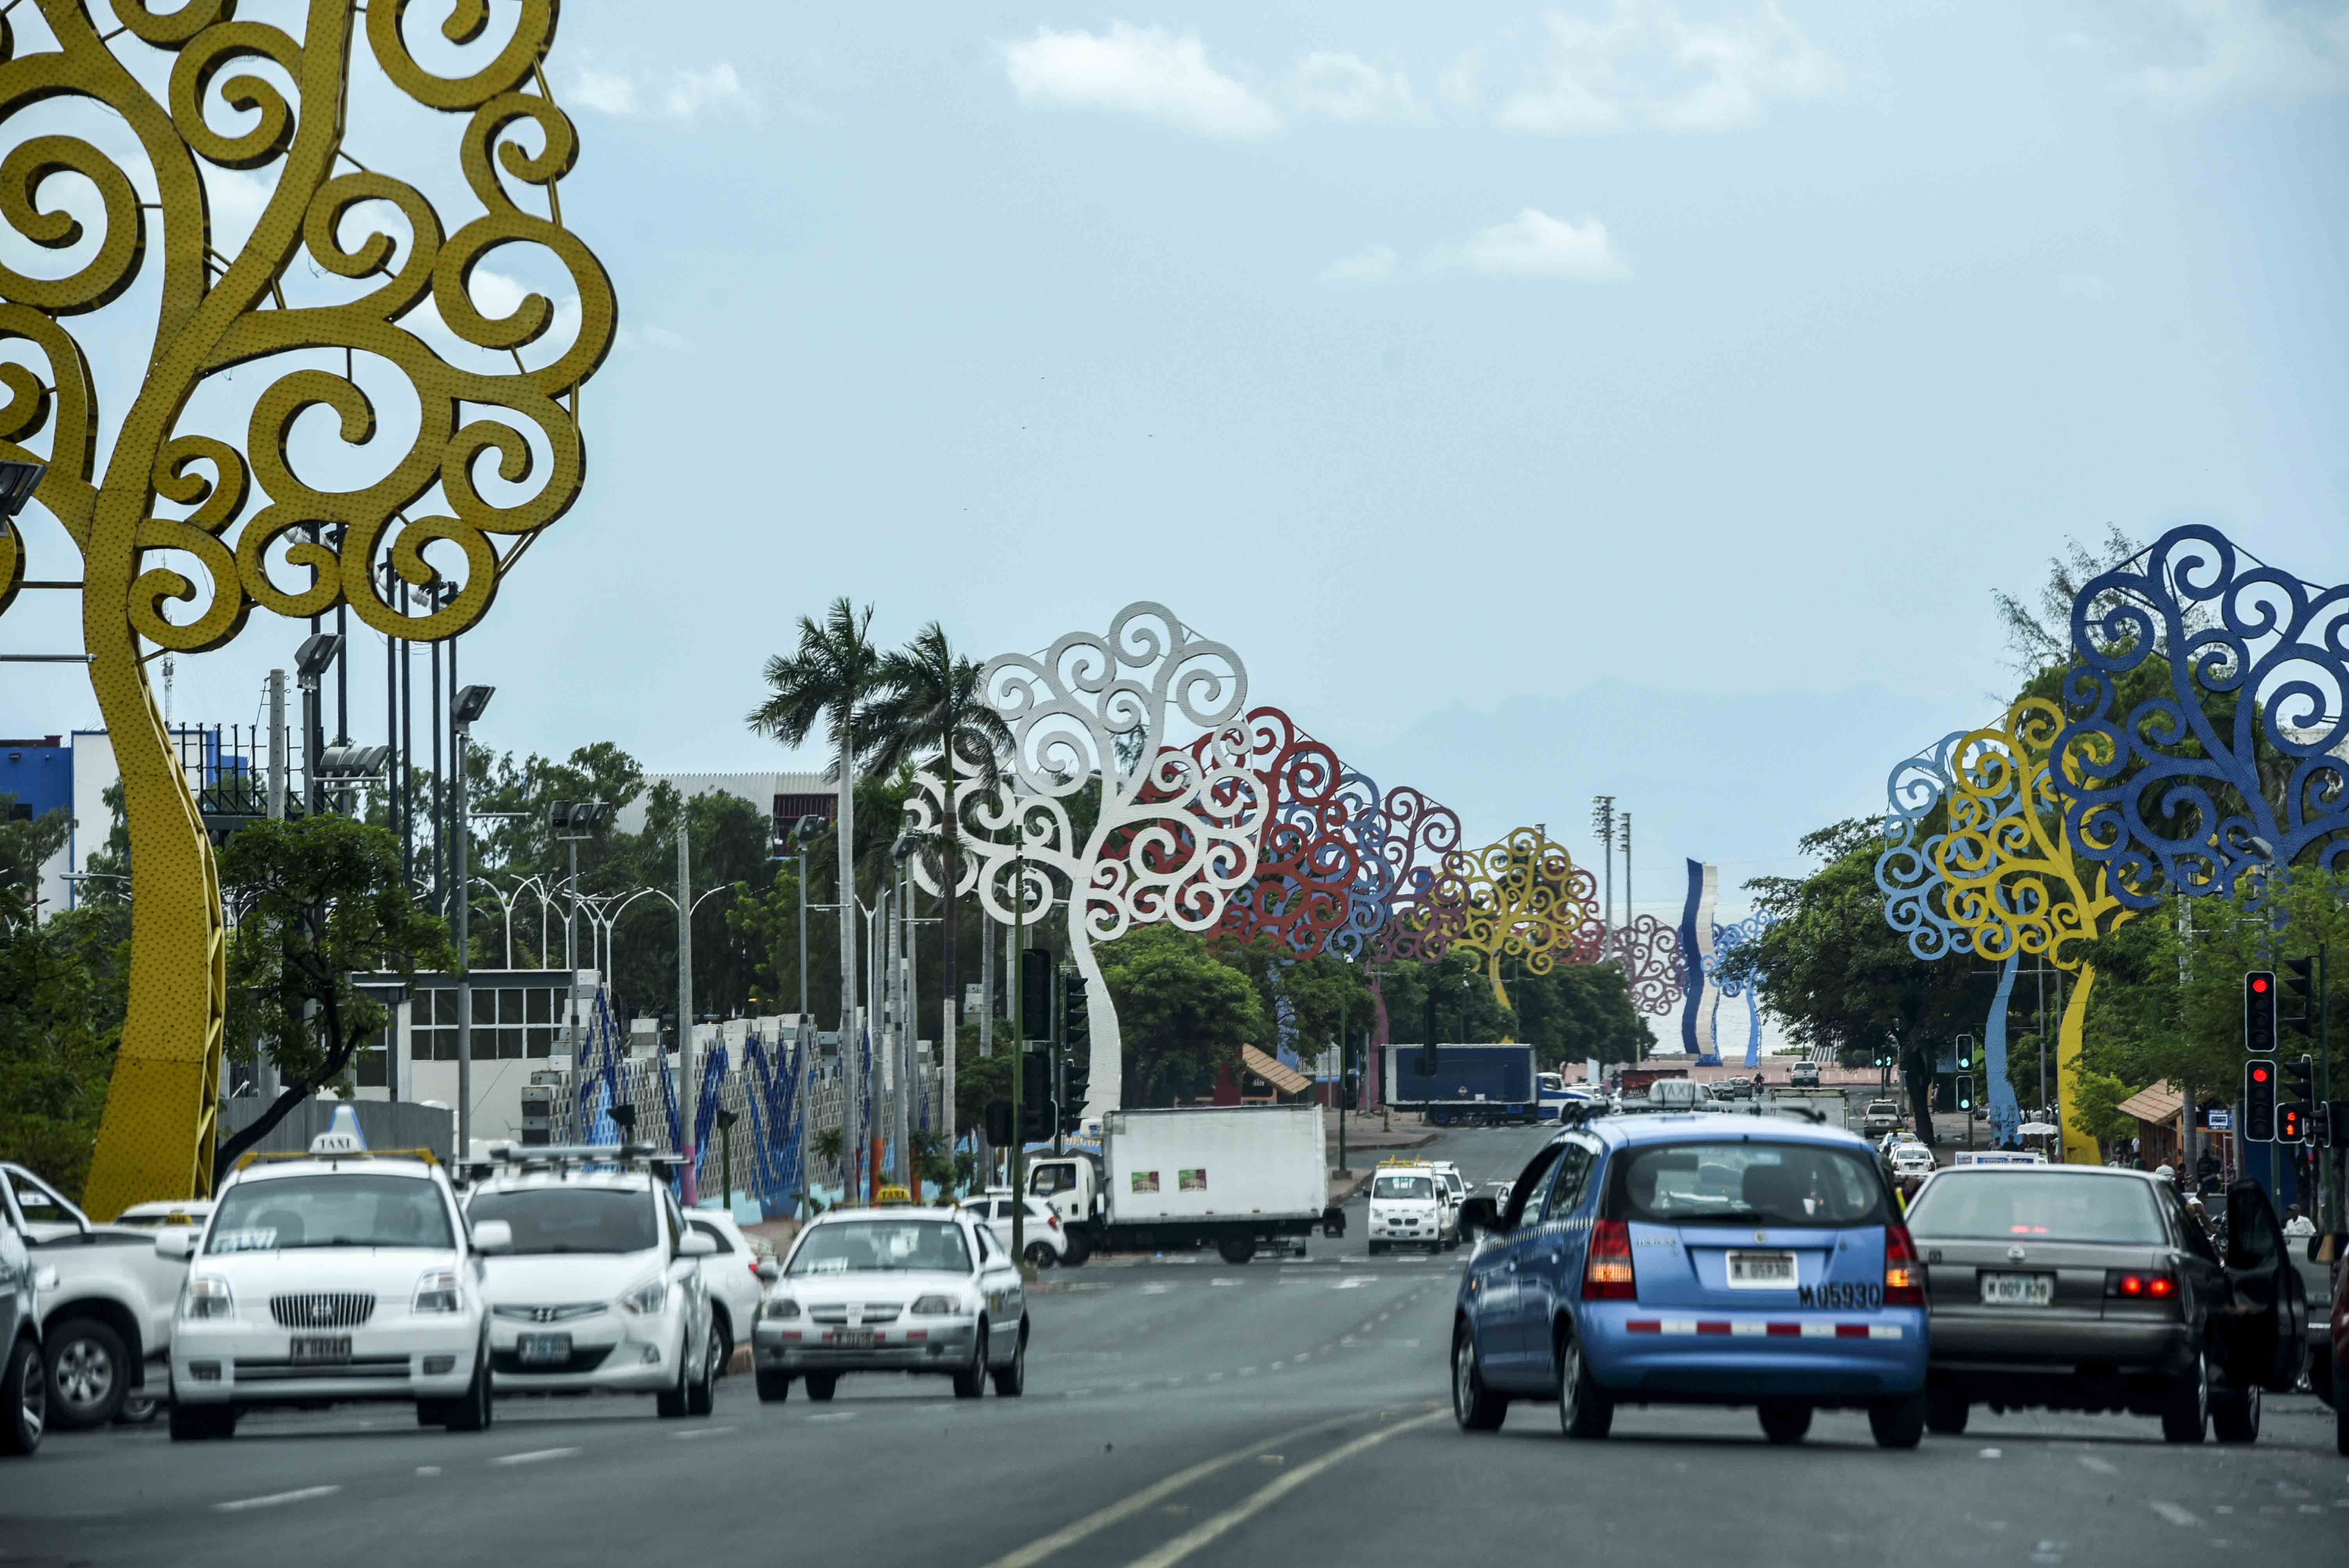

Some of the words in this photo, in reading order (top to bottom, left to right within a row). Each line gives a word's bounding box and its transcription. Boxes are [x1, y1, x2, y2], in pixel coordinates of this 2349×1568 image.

[320, 1138, 350, 1149] TAXI
[881, 1190, 905, 1200] TAXI
[1735, 1263, 1742, 1278] M
[1798, 1282, 1880, 1308] M05930
